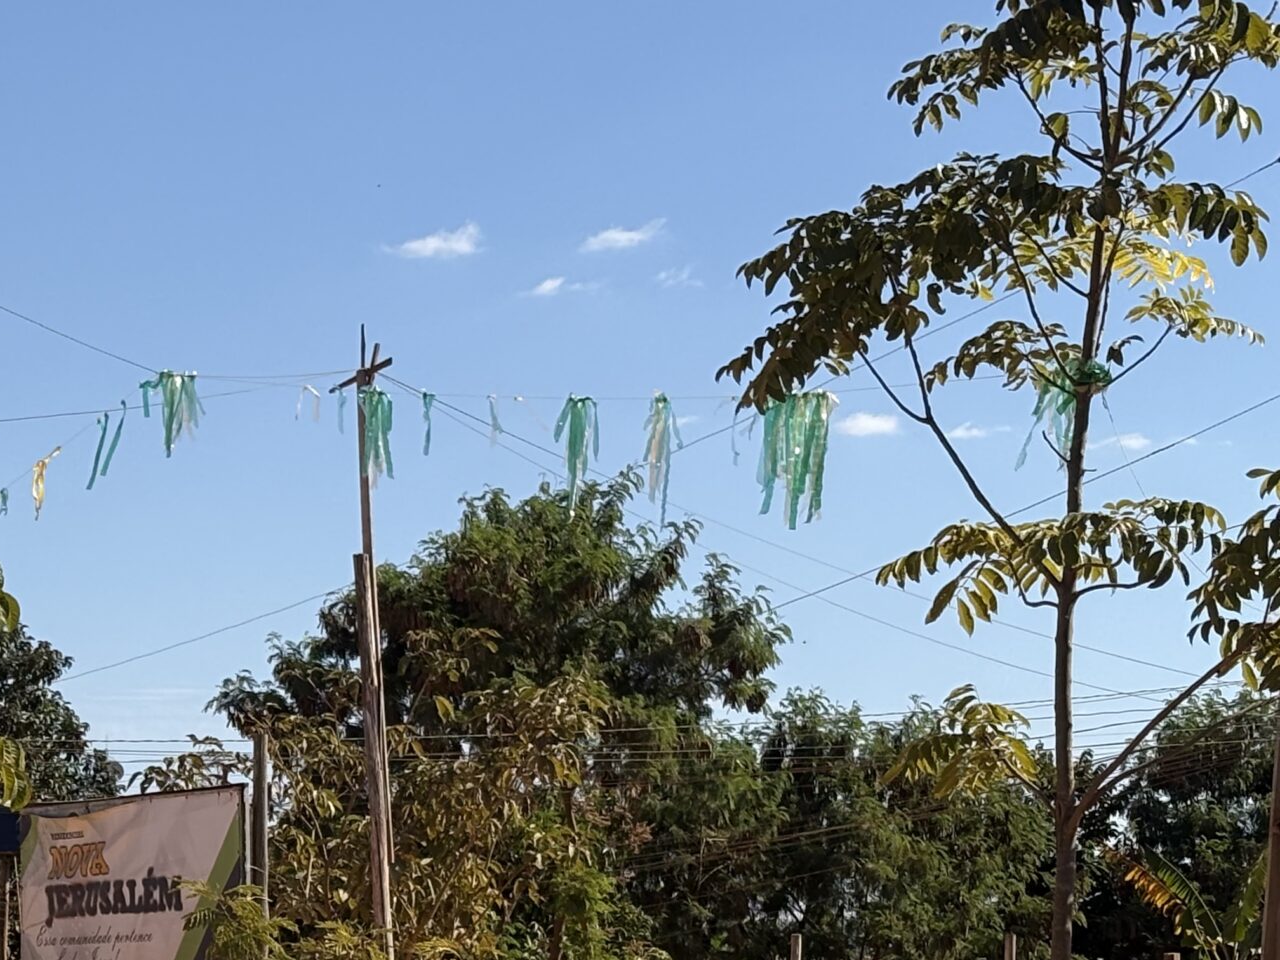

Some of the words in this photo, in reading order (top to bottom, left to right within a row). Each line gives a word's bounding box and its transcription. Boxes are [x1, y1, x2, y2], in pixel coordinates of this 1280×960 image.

[48, 841, 110, 880] NOVA
[45, 867, 183, 927] JERUSALÉM
[36, 925, 58, 947] Essa
[60, 925, 112, 946] comunidade
[112, 929, 153, 951] pertence
